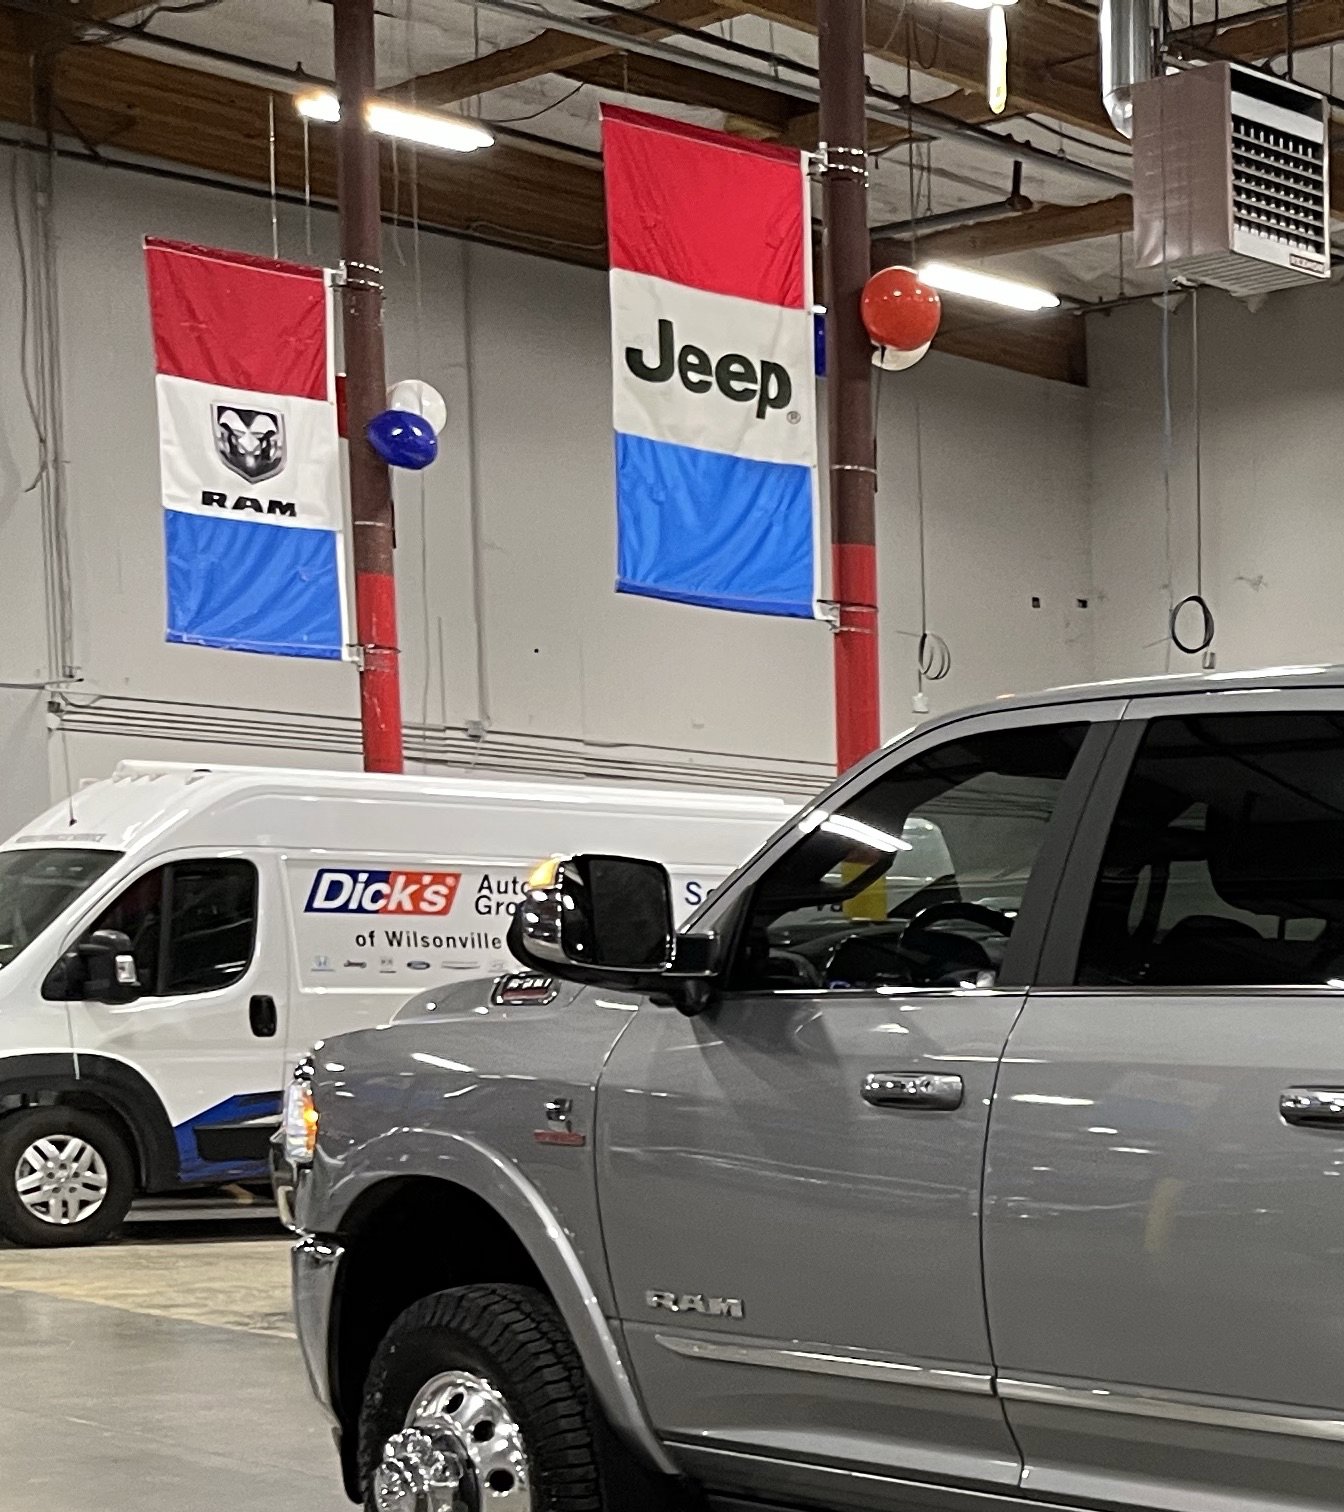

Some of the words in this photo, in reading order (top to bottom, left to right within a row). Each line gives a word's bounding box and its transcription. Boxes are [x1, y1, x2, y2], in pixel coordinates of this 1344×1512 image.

[625, 318, 792, 420] Jeep
[201, 490, 297, 517] RAM
[312, 872, 450, 913] Dick's
[475, 895, 517, 916] Gro
[355, 930, 375, 947] of
[385, 931, 502, 949] Wilsonville
[645, 1289, 744, 1317] RAM
